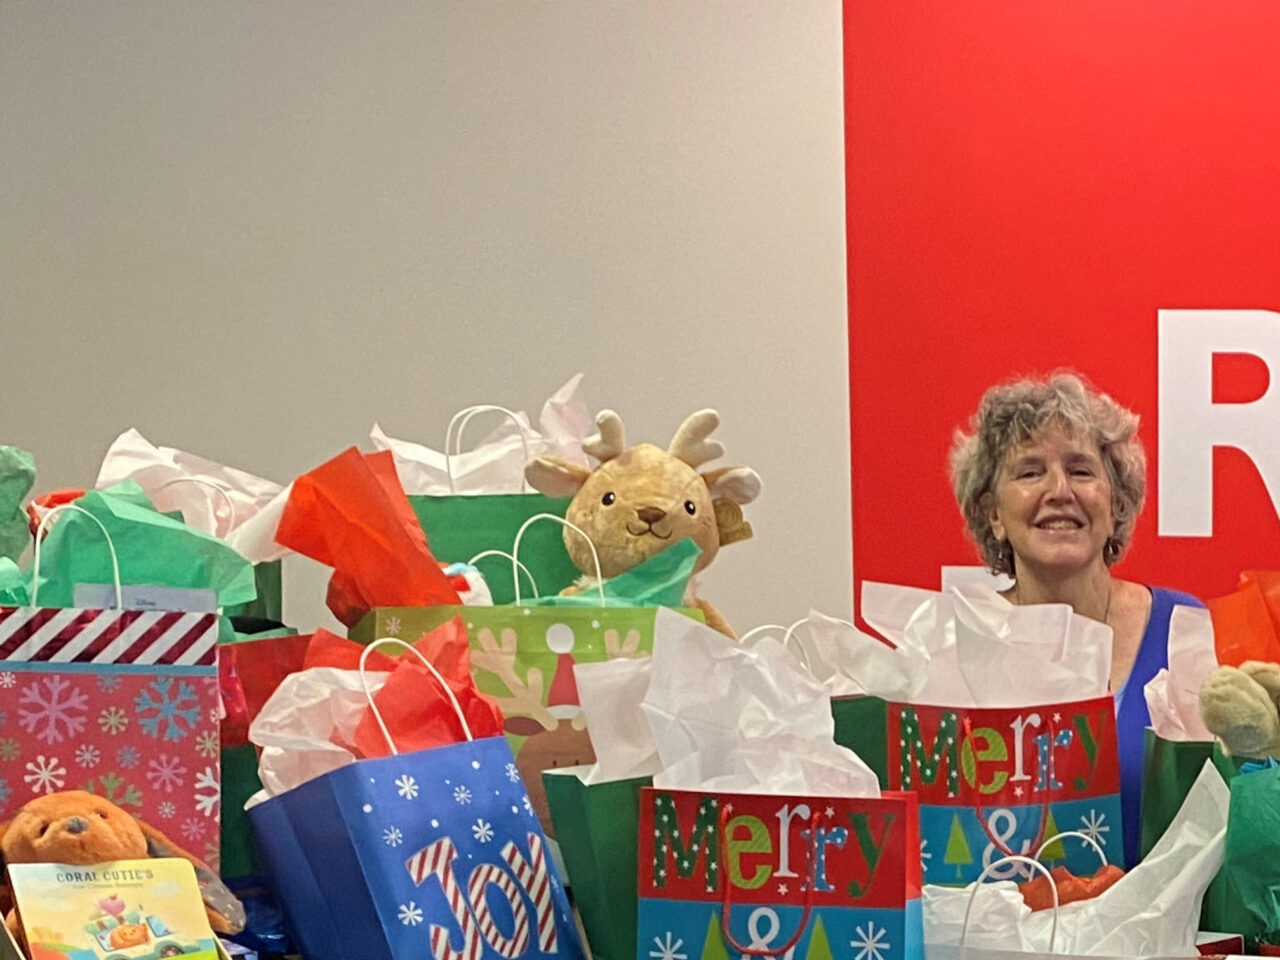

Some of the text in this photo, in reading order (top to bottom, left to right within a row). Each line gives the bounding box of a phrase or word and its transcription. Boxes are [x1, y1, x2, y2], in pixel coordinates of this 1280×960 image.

[899, 707, 1108, 799] Merry
[56, 868, 154, 883] CORAL CUTIE'S
[653, 791, 897, 898] Merry
[982, 808, 1034, 882] &
